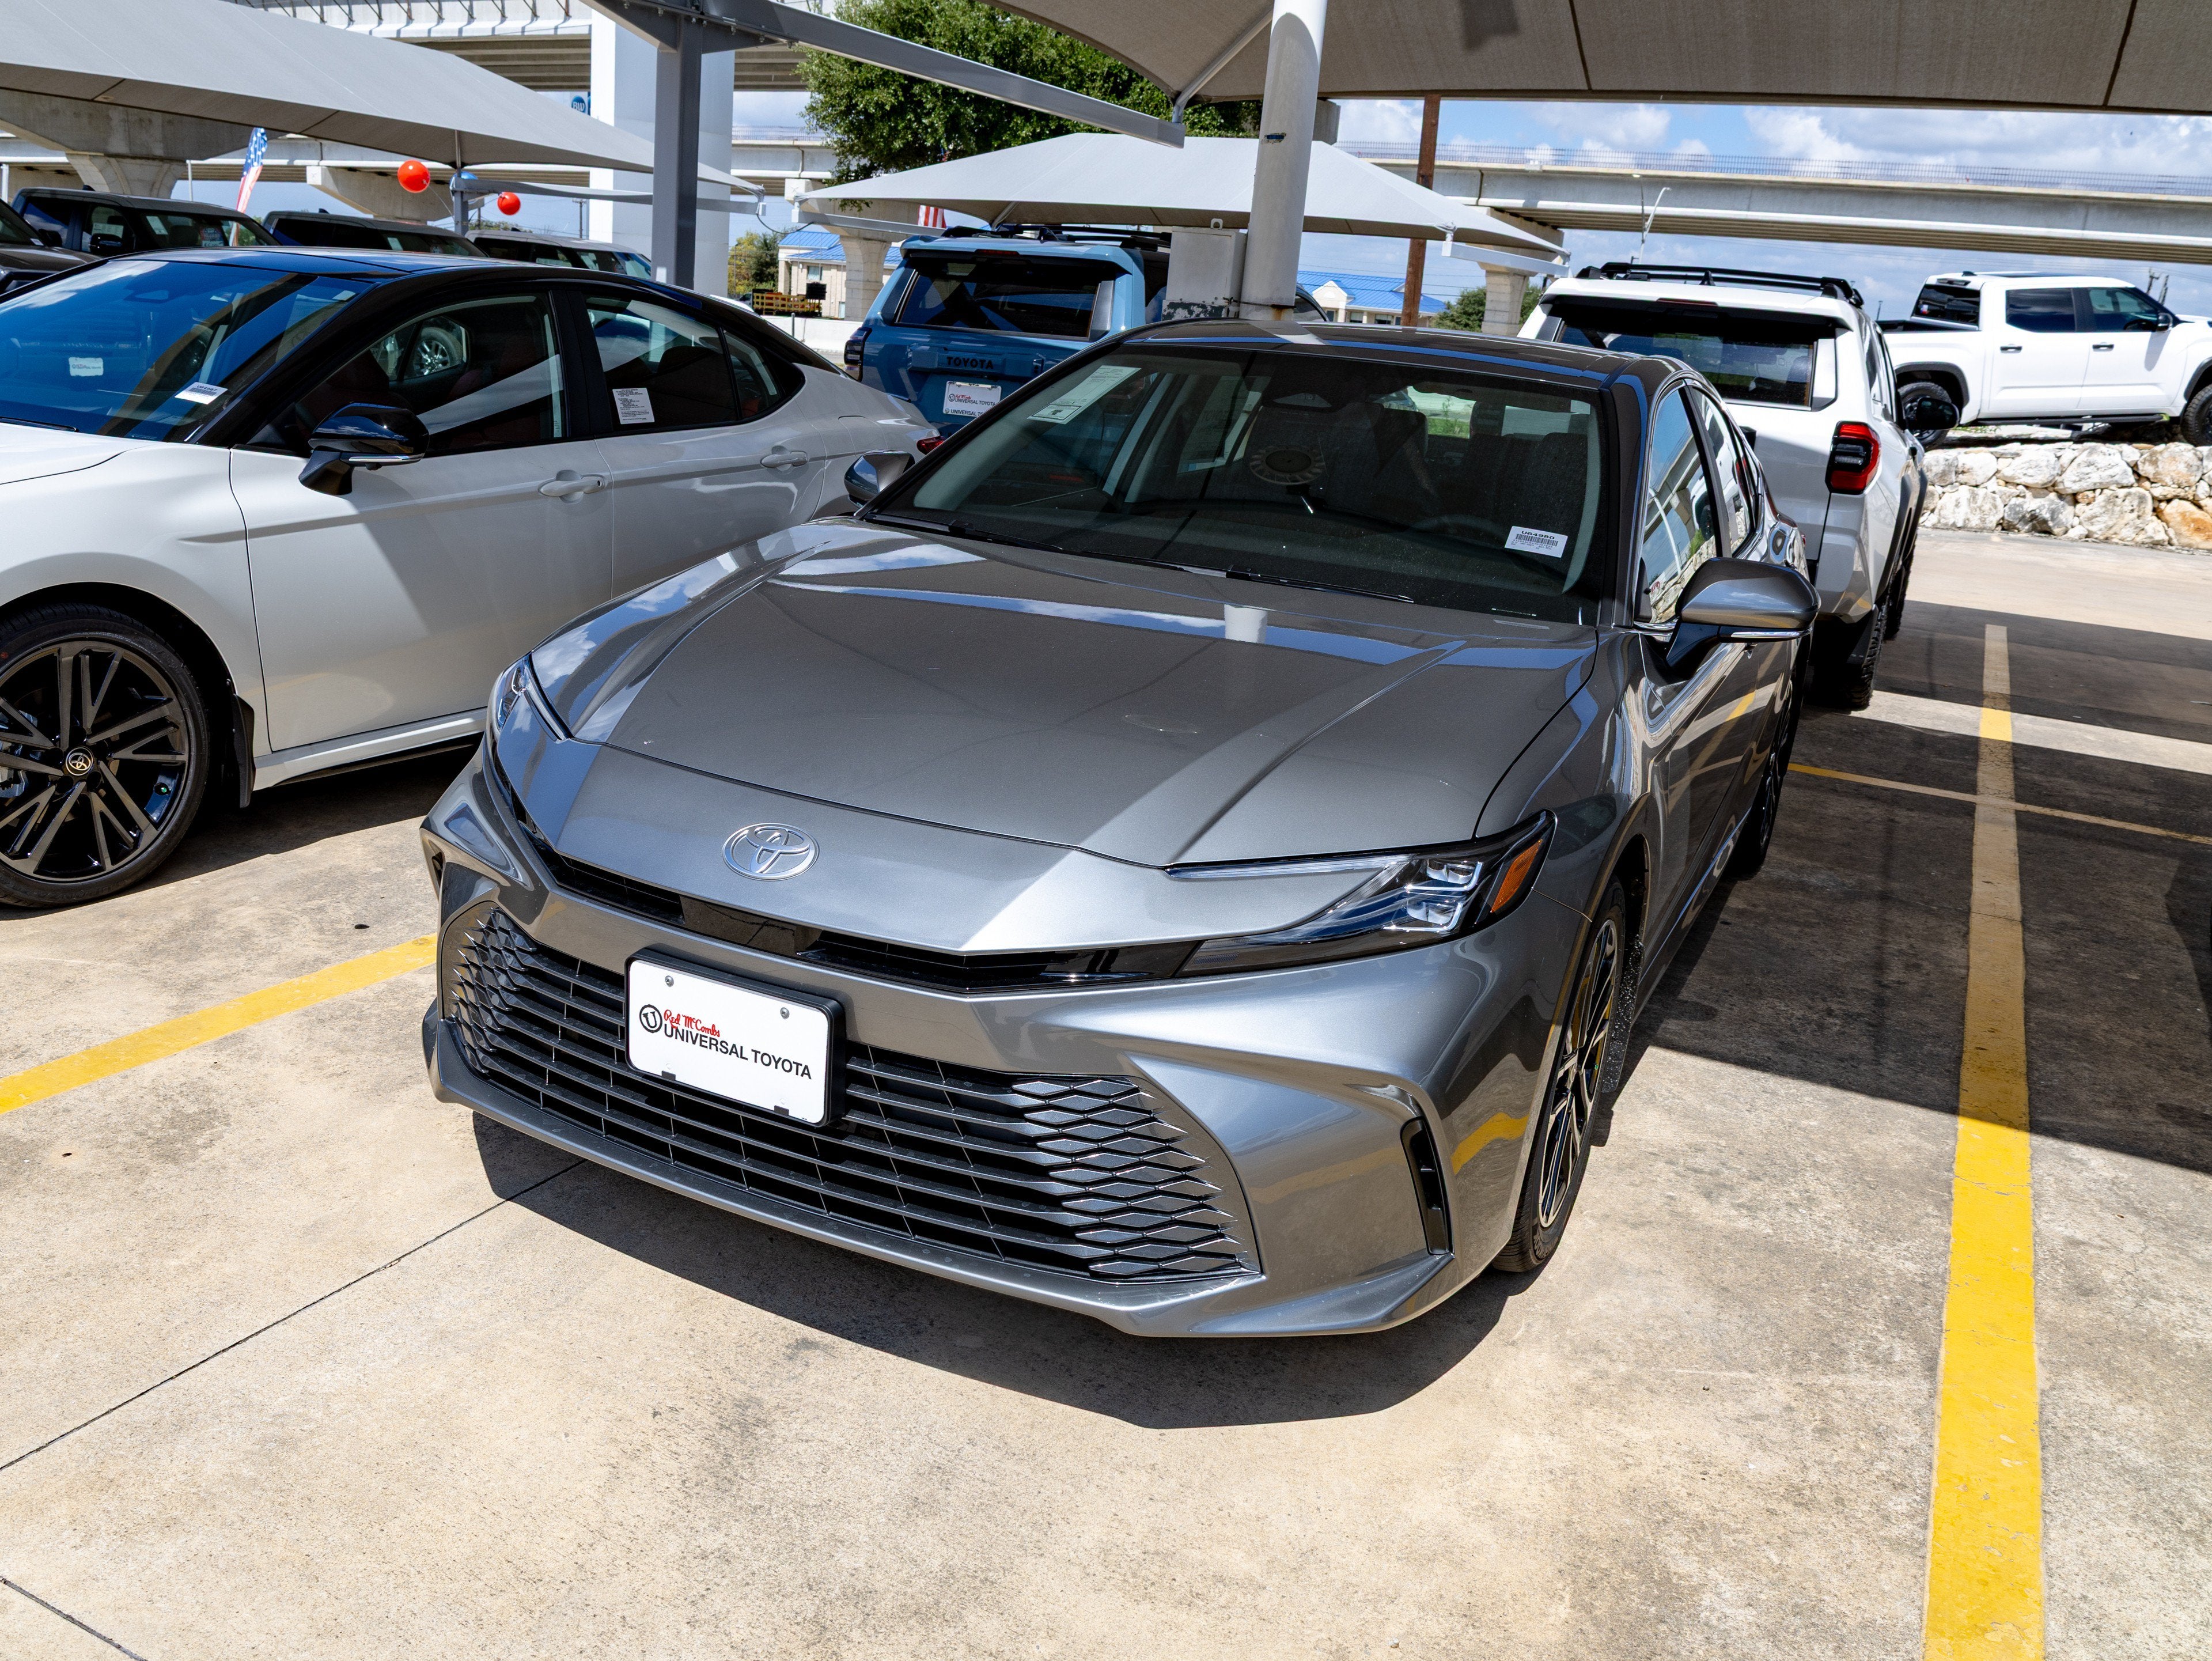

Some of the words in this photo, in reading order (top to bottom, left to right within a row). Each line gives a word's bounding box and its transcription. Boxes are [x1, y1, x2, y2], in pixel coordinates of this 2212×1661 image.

[946, 357, 994, 369] TOYOTA
[950, 408, 978, 417] UNIVERSAL
[1521, 531, 1555, 540] U64980
[664, 1009, 680, 1028] Red
[664, 1023, 748, 1061] UNIVERSAL
[751, 1049, 812, 1080] TOYOTA
